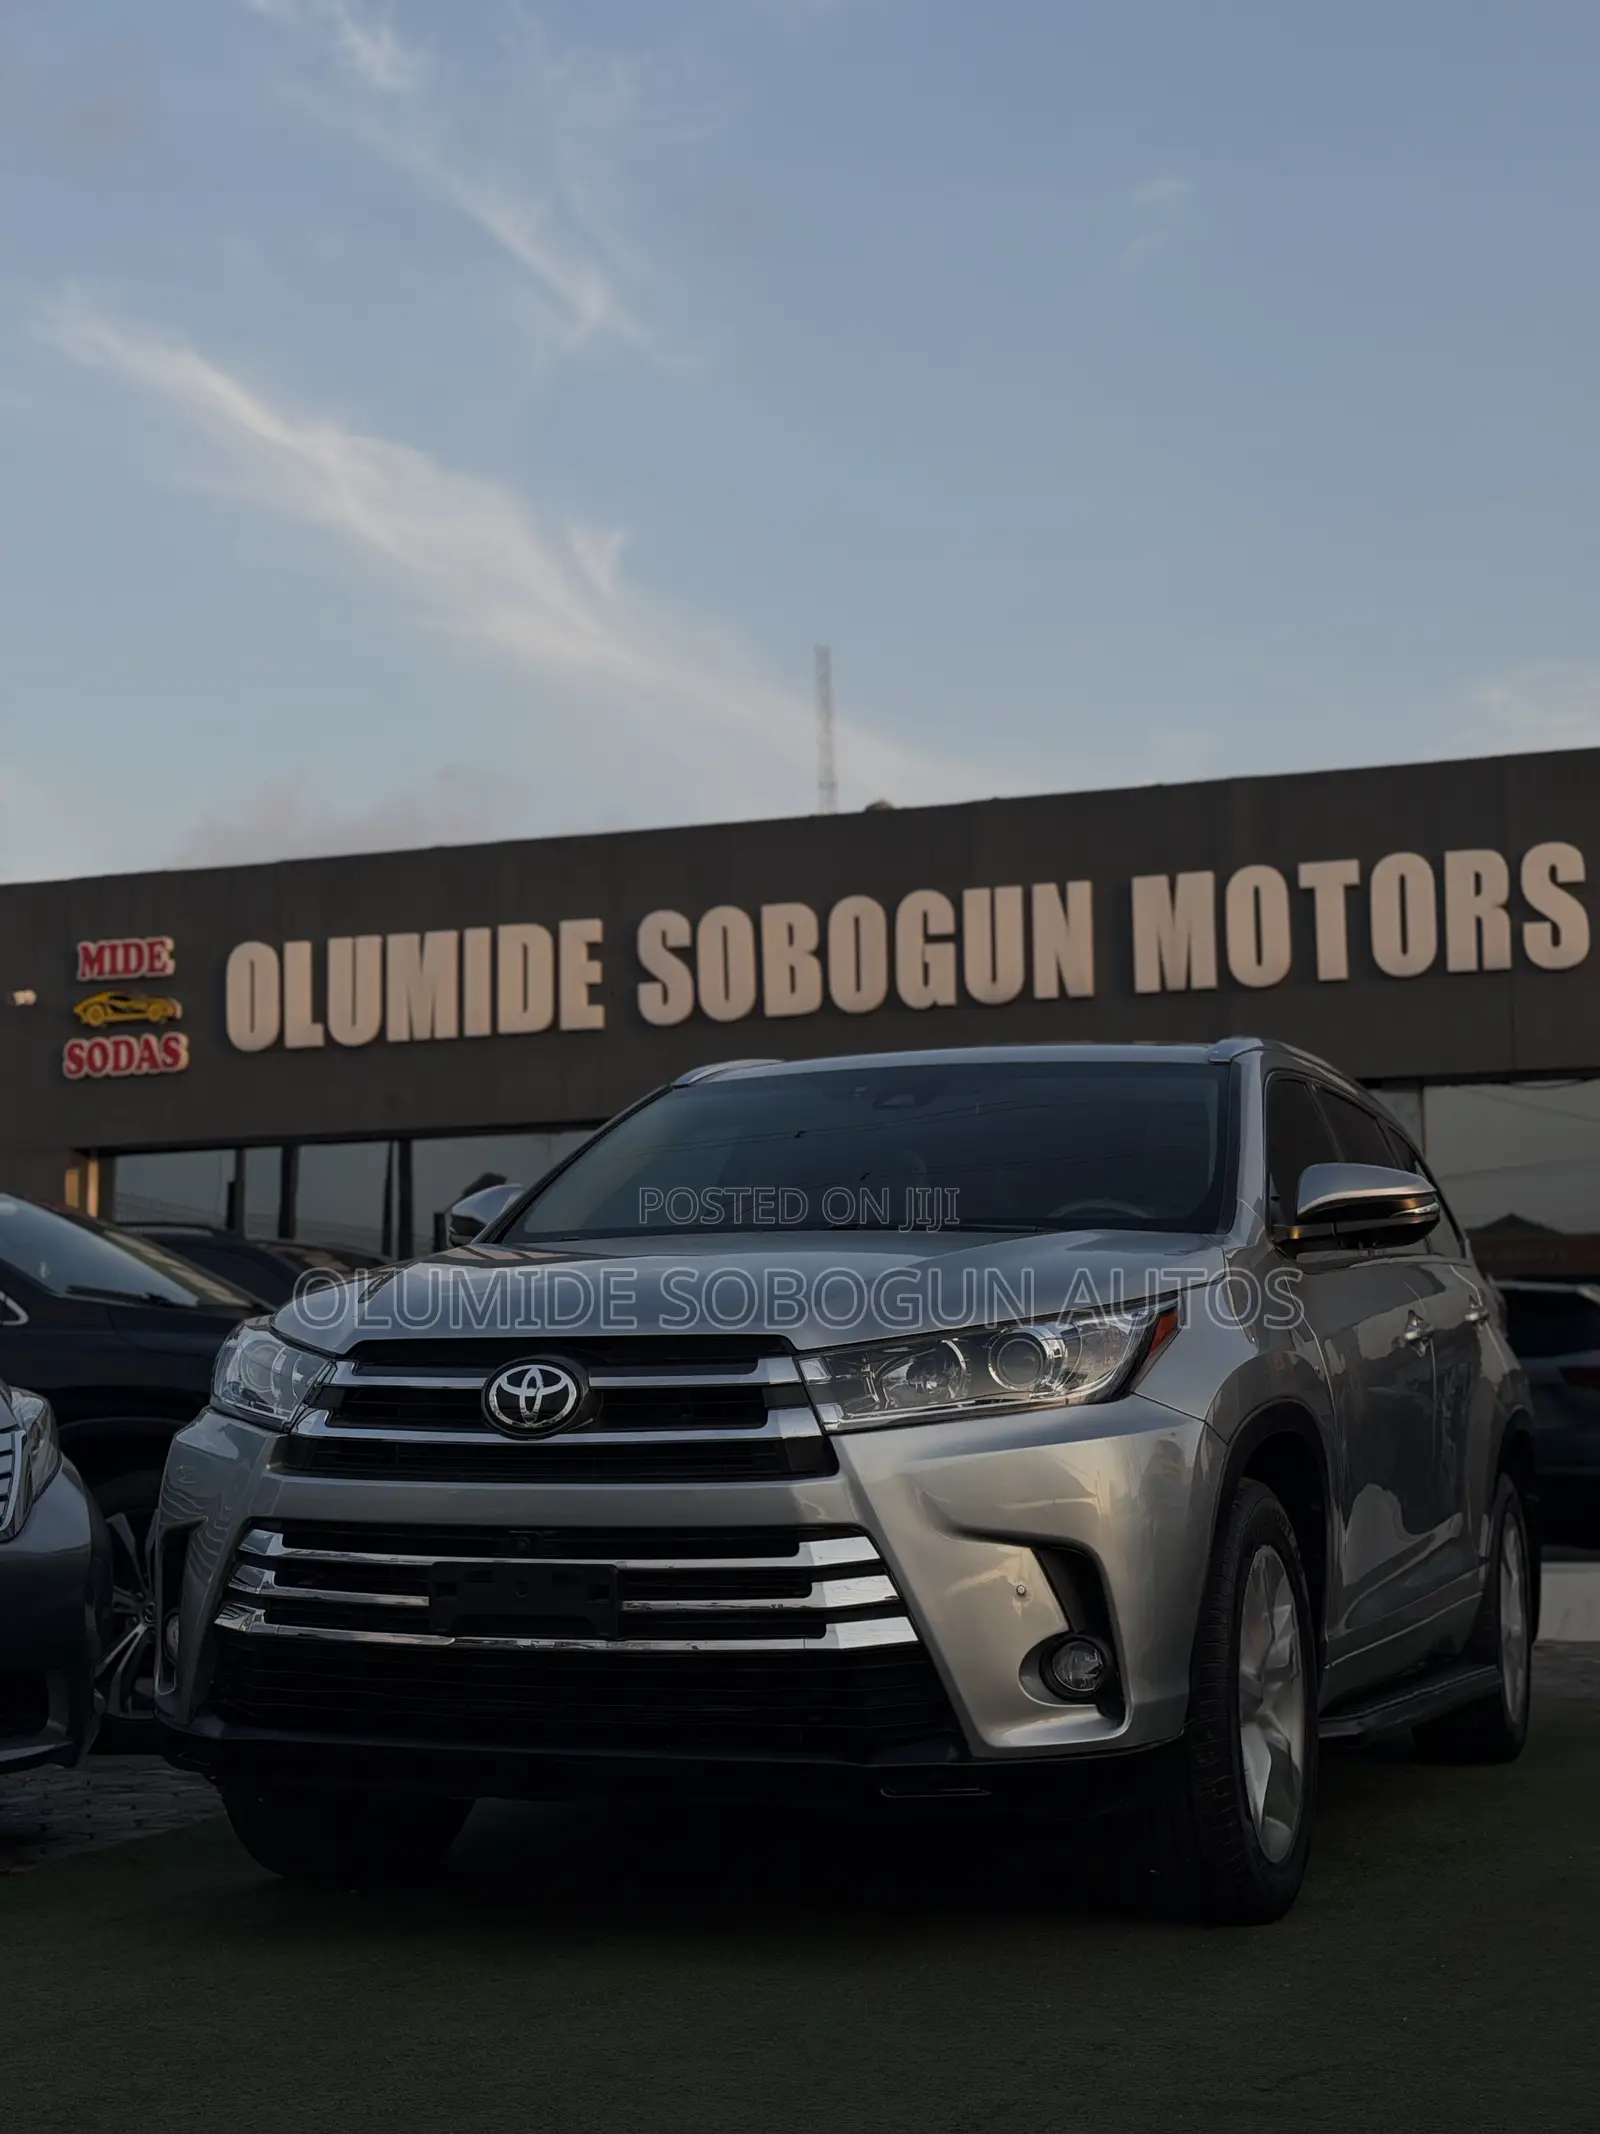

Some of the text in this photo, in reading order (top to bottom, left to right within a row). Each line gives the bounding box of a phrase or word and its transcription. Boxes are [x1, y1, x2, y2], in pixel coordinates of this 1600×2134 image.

[77, 936, 175, 982] MIDE
[225, 841, 1590, 1052] OLUMIDE SOBOGUN MOTORS
[63, 1032, 189, 1079] SODAS
